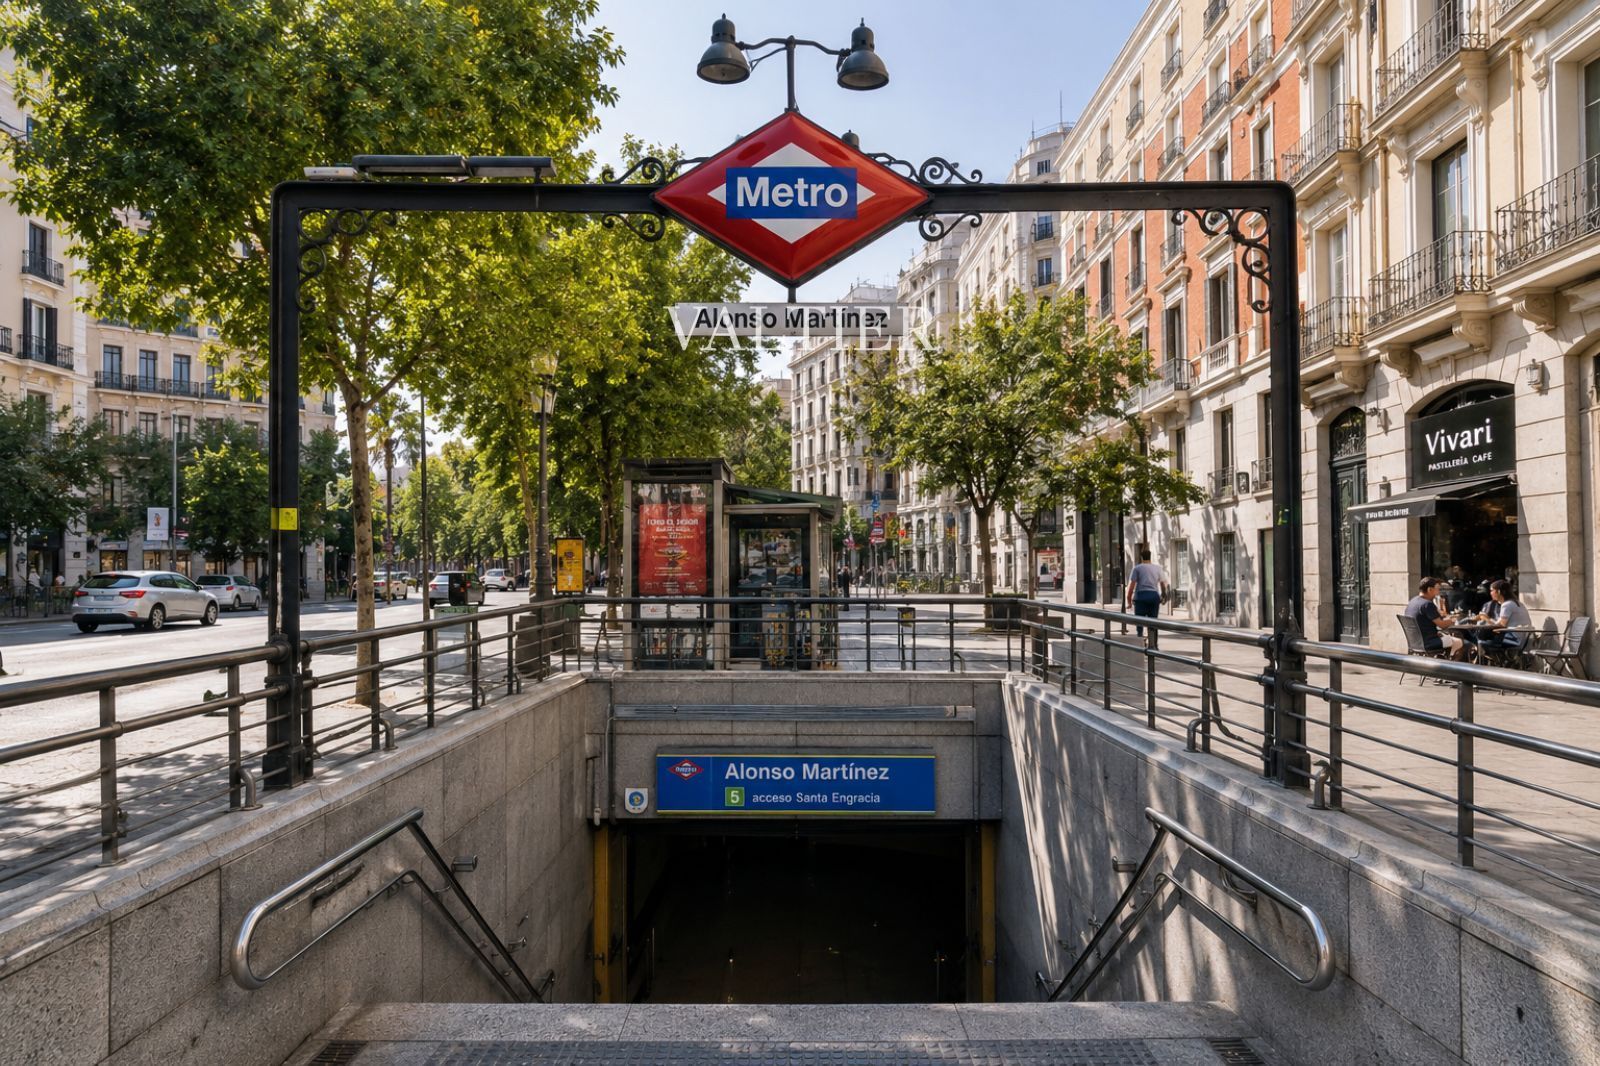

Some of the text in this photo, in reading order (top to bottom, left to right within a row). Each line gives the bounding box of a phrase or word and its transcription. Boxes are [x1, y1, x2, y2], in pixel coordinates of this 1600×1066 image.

[737, 176, 848, 207] Metro
[695, 307, 888, 328] Alonso Martínez
[1425, 418, 1493, 456] Vivari
[725, 762, 889, 780] Alonso Martínez
[730, 790, 880, 805] 5 acceso Santa Engracia
